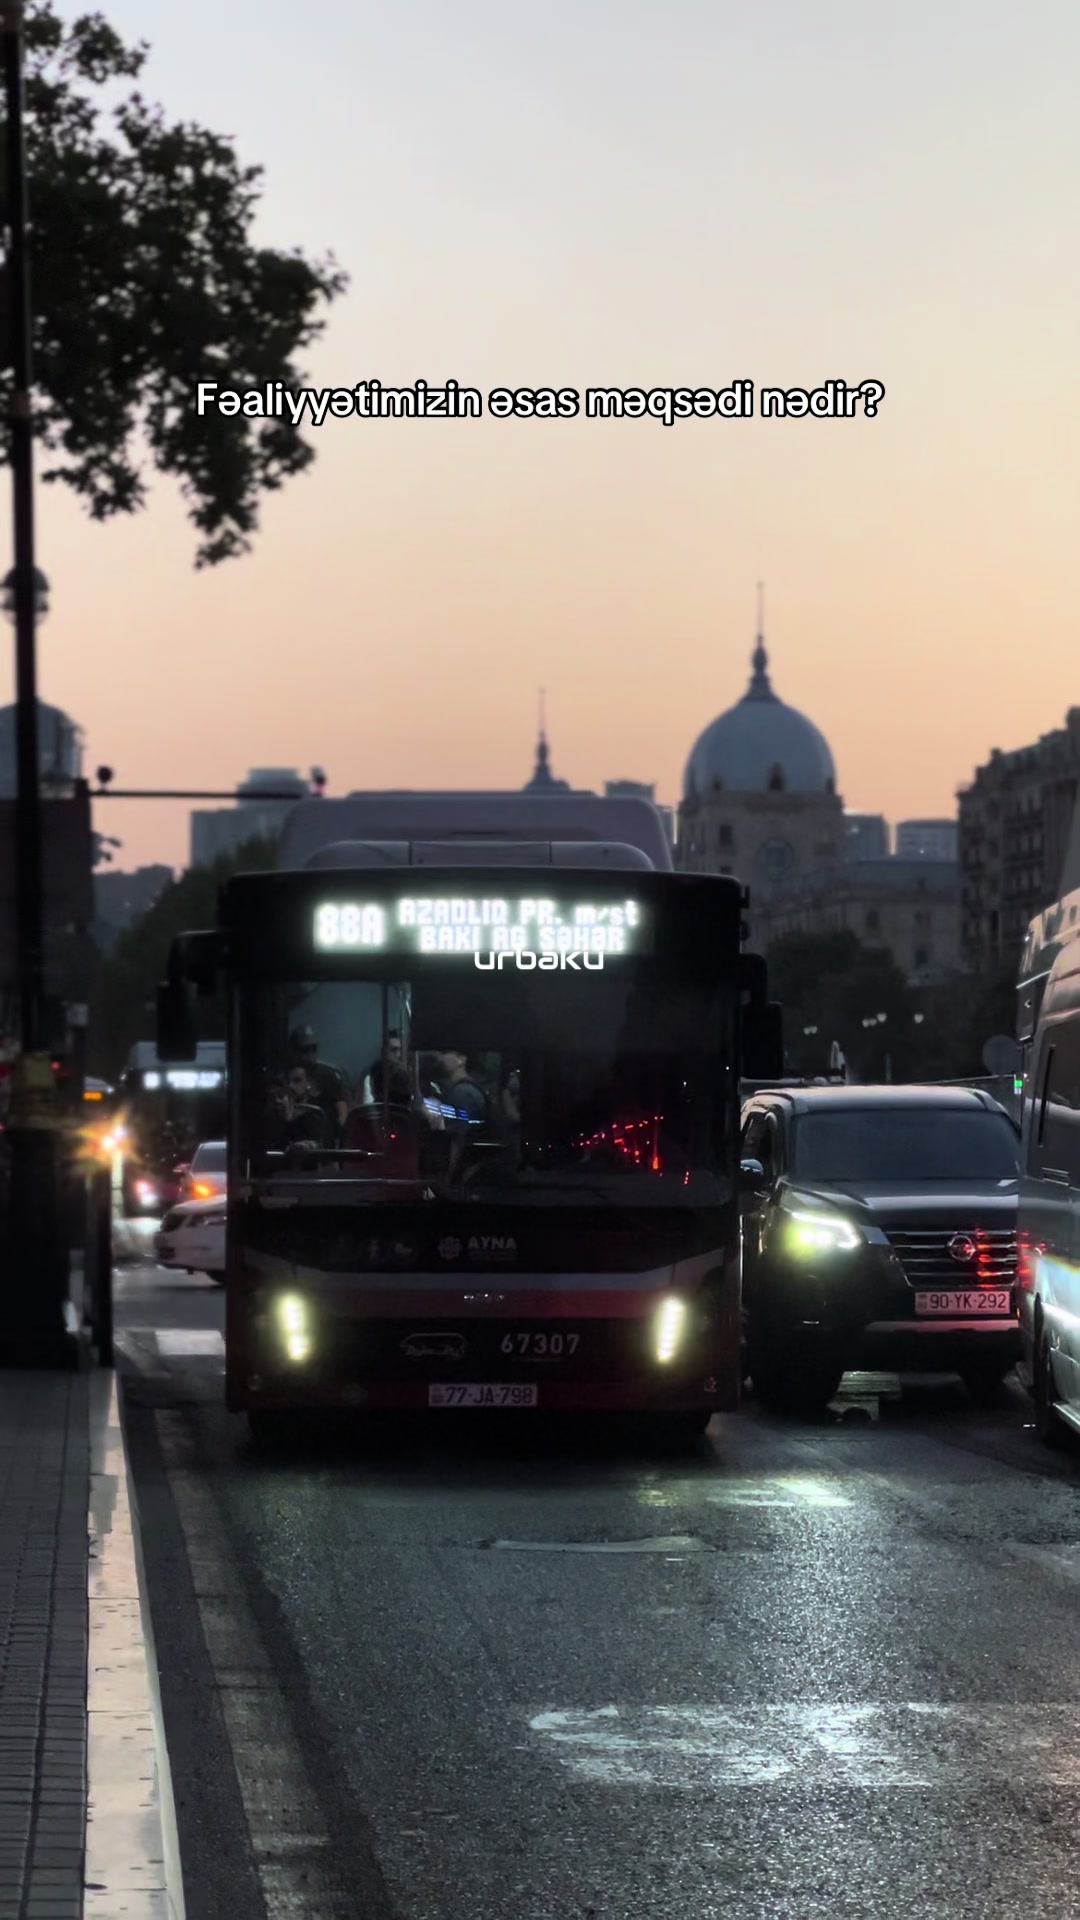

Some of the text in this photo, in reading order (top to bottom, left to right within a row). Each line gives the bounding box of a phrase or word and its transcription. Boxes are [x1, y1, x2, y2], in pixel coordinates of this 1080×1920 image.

[317, 904, 384, 945] 88A
[420, 926, 481, 951] BAKI
[467, 1236, 517, 1250] AYNA
[929, 1293, 1007, 1309] 90-YK-292
[500, 1332, 581, 1355] 67307
[445, 1386, 533, 1404] 77-JA-798
